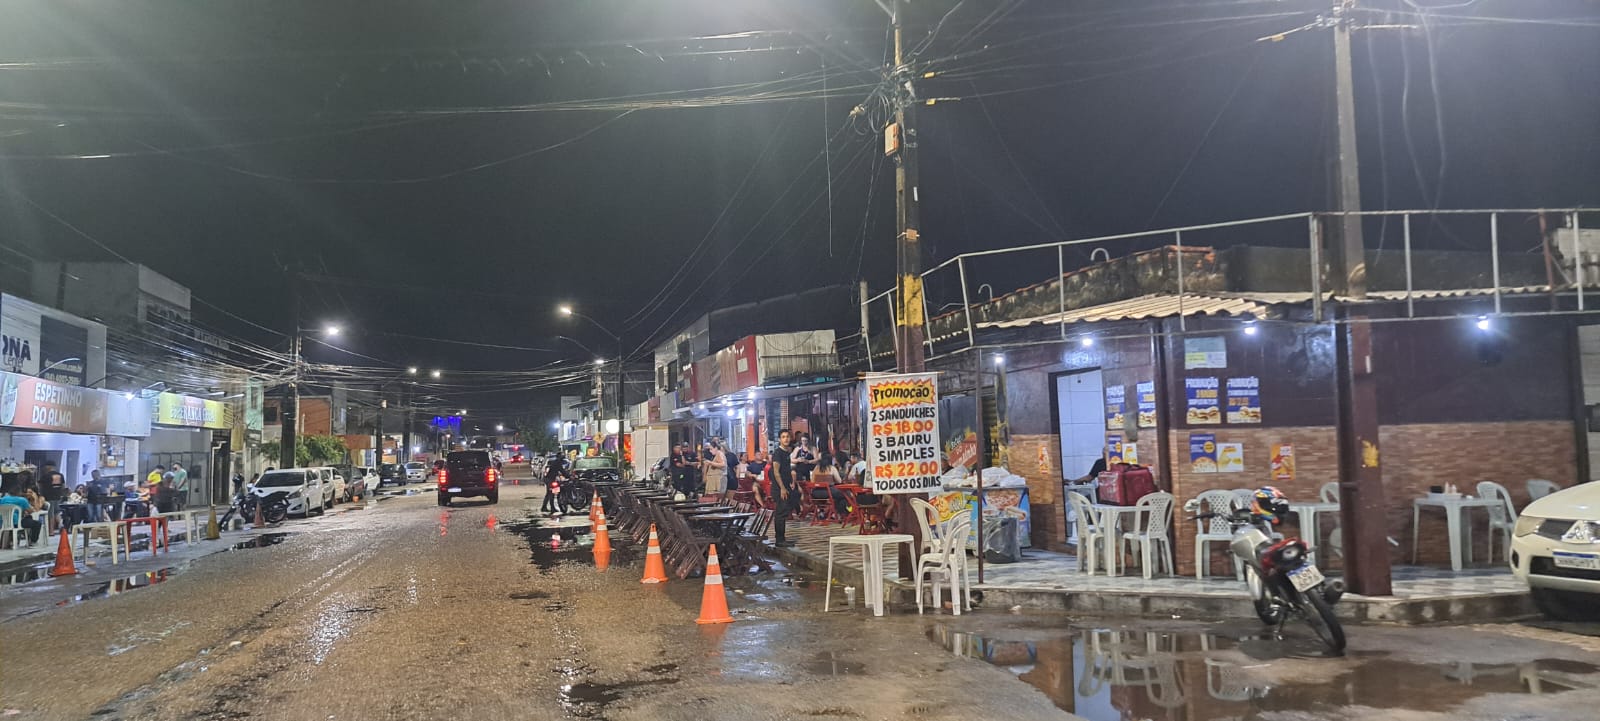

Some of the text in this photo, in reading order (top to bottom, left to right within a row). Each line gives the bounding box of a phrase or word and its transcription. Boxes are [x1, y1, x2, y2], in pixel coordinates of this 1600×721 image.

[35, 382, 82, 407] ESPETINHO
[32, 405, 47, 424] DO
[48, 408, 72, 427] ALMA
[871, 407, 935, 422] 2 SANDUICHES
[873, 422, 893, 436] R$
[875, 434, 931, 449] 3 BAURU
[879, 447, 935, 462] SIMPLES
[875, 464, 893, 479] R$
[875, 475, 941, 490] TODOS OS DIAS
